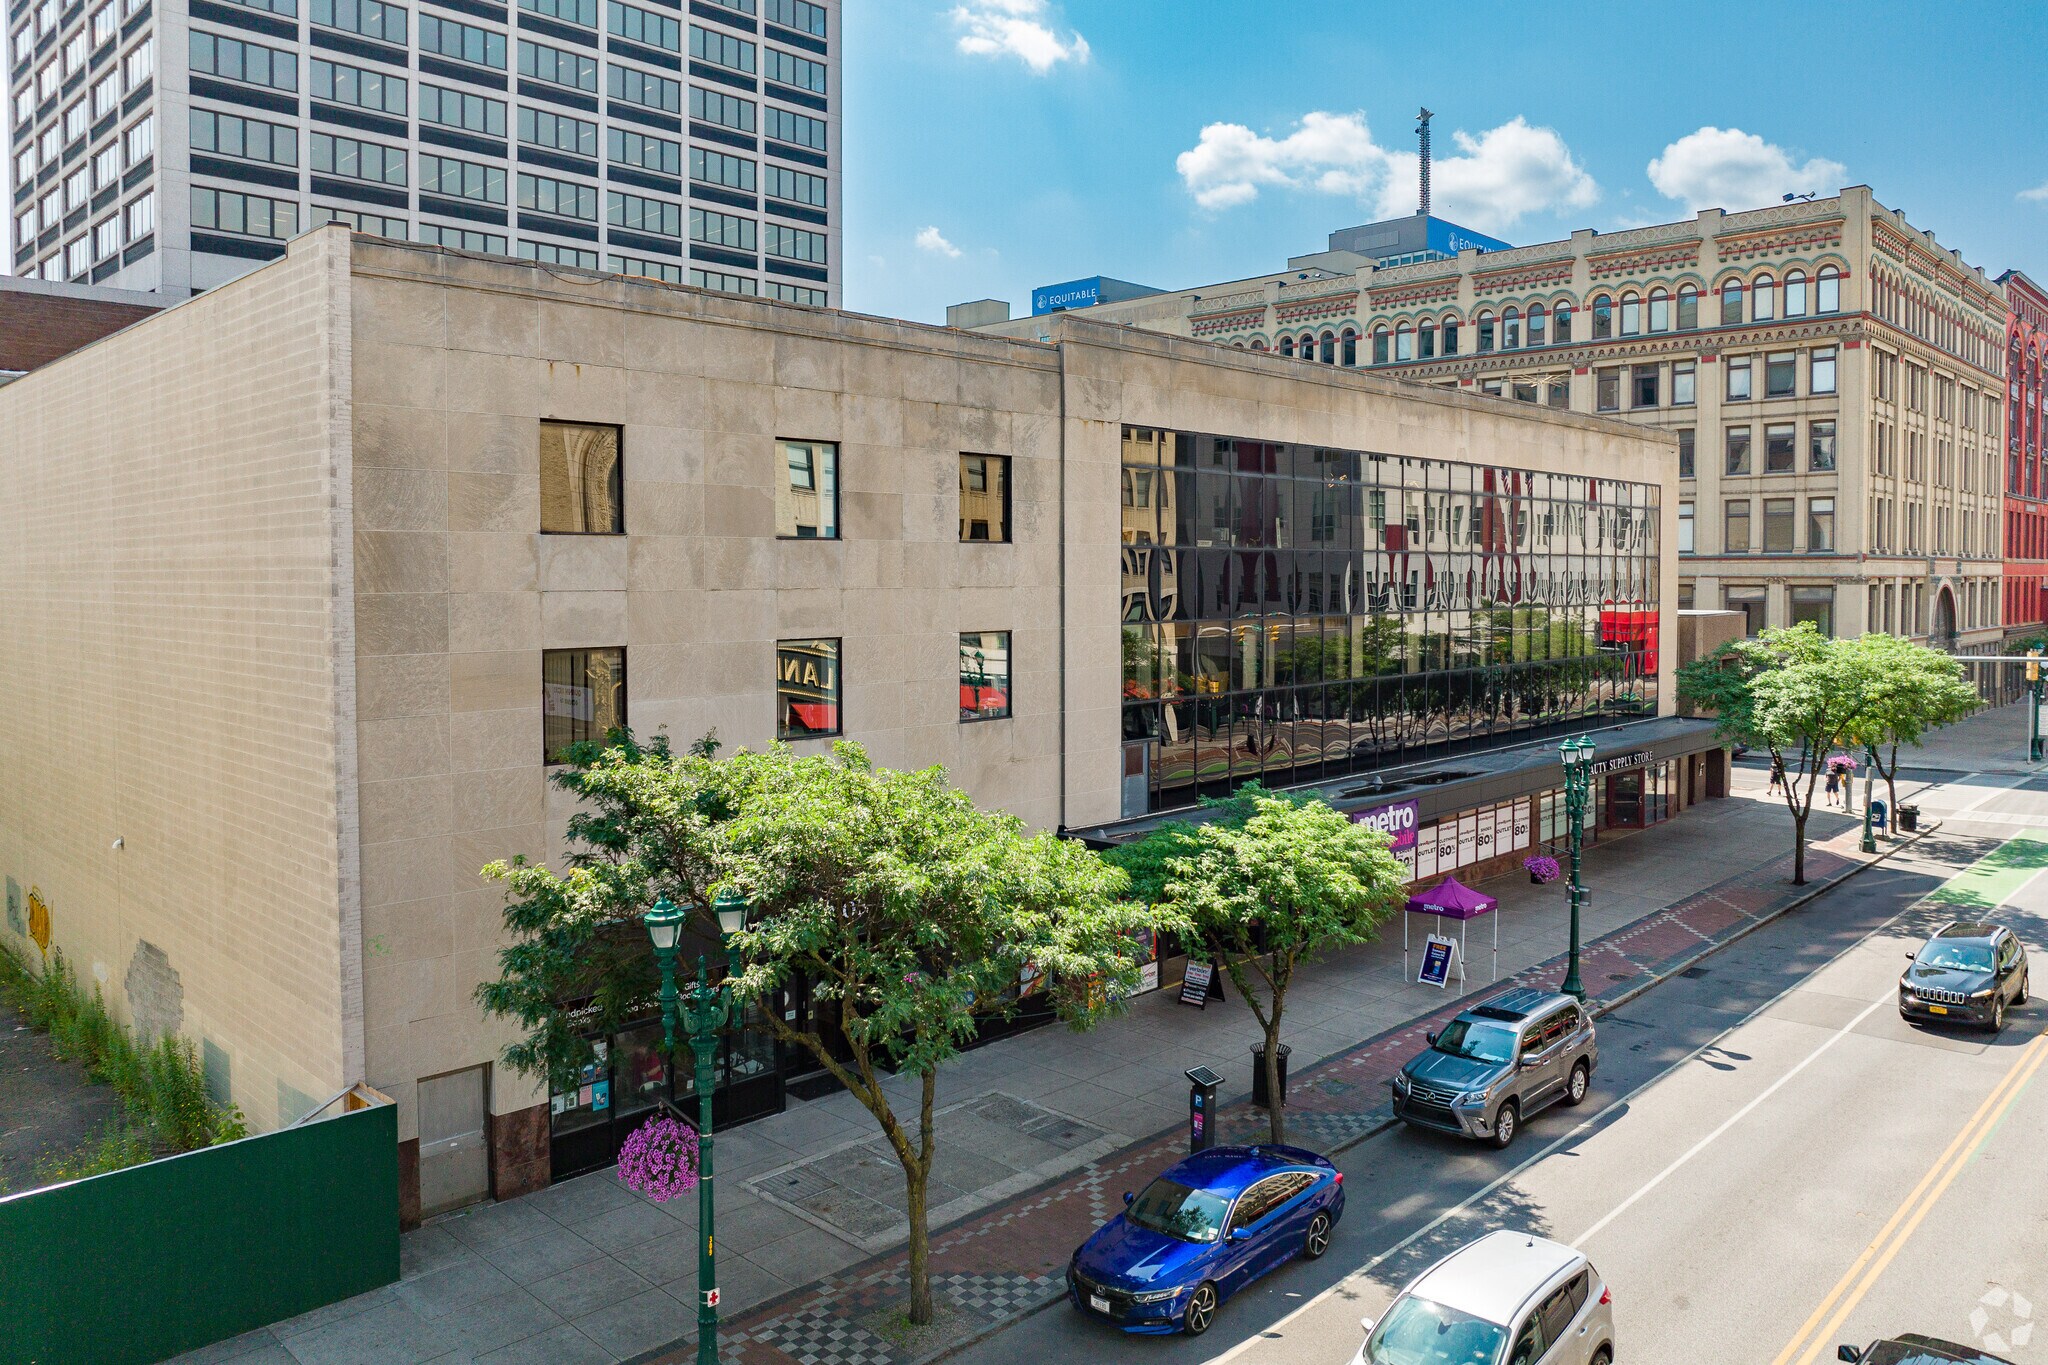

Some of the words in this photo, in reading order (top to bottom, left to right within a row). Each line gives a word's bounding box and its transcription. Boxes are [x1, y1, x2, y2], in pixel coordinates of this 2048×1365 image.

[1049, 288, 1096, 305] EQUITABLE
[1609, 755, 1632, 771] SUPPLY
[1633, 750, 1653, 765] STORE
[1459, 836, 1475, 845] OUTLET
[1418, 847, 1436, 856] OUTLET
[1424, 904, 1444, 912] metro
[1475, 903, 1487, 913] metro
[684, 981, 700, 991] Gifts
[1195, 1094, 1202, 1104] P
